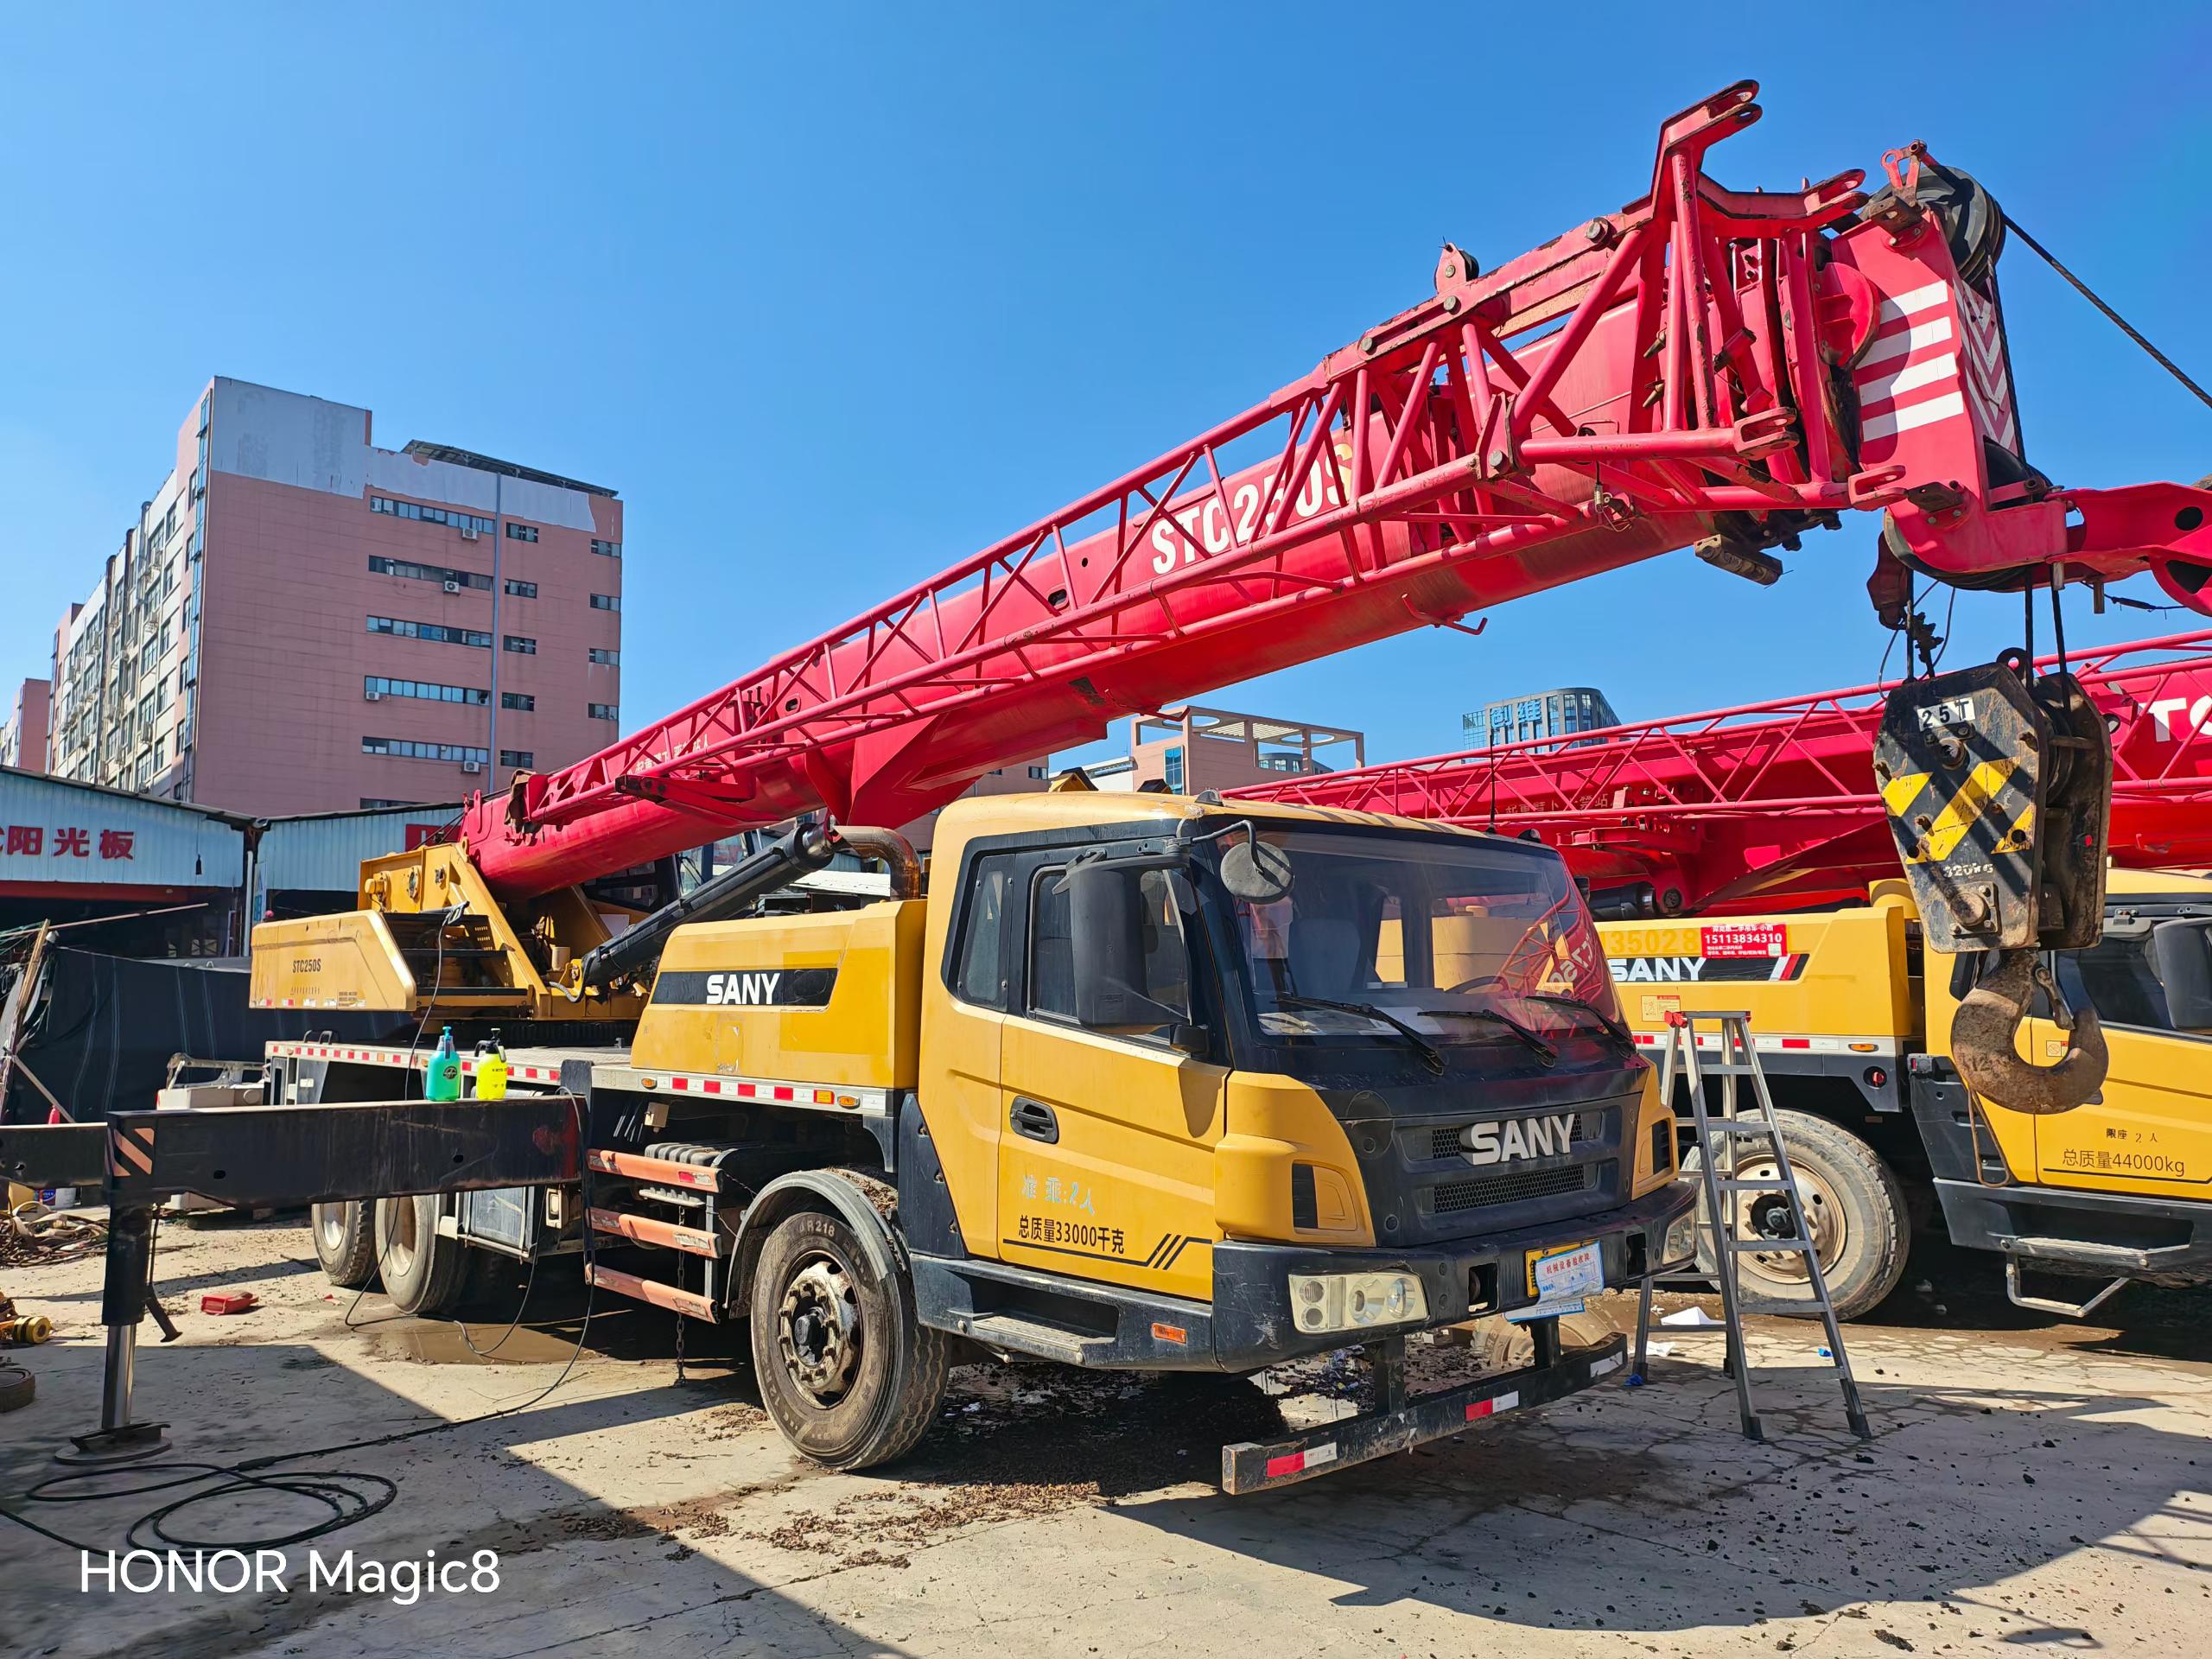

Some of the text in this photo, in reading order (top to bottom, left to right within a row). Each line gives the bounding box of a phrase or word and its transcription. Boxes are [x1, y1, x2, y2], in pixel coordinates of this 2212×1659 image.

[1491, 699, 1541, 728] 创维
[1705, 932, 1783, 944] 15113834310
[292, 958, 321, 974] STC250S
[1607, 957, 1707, 982] SANY
[706, 972, 781, 1005] SANY
[1471, 1113, 1575, 1166] SANY
[2063, 1148, 2185, 1178] 总质量44000kg
[1019, 1214, 1125, 1255] 总质量33000千克
